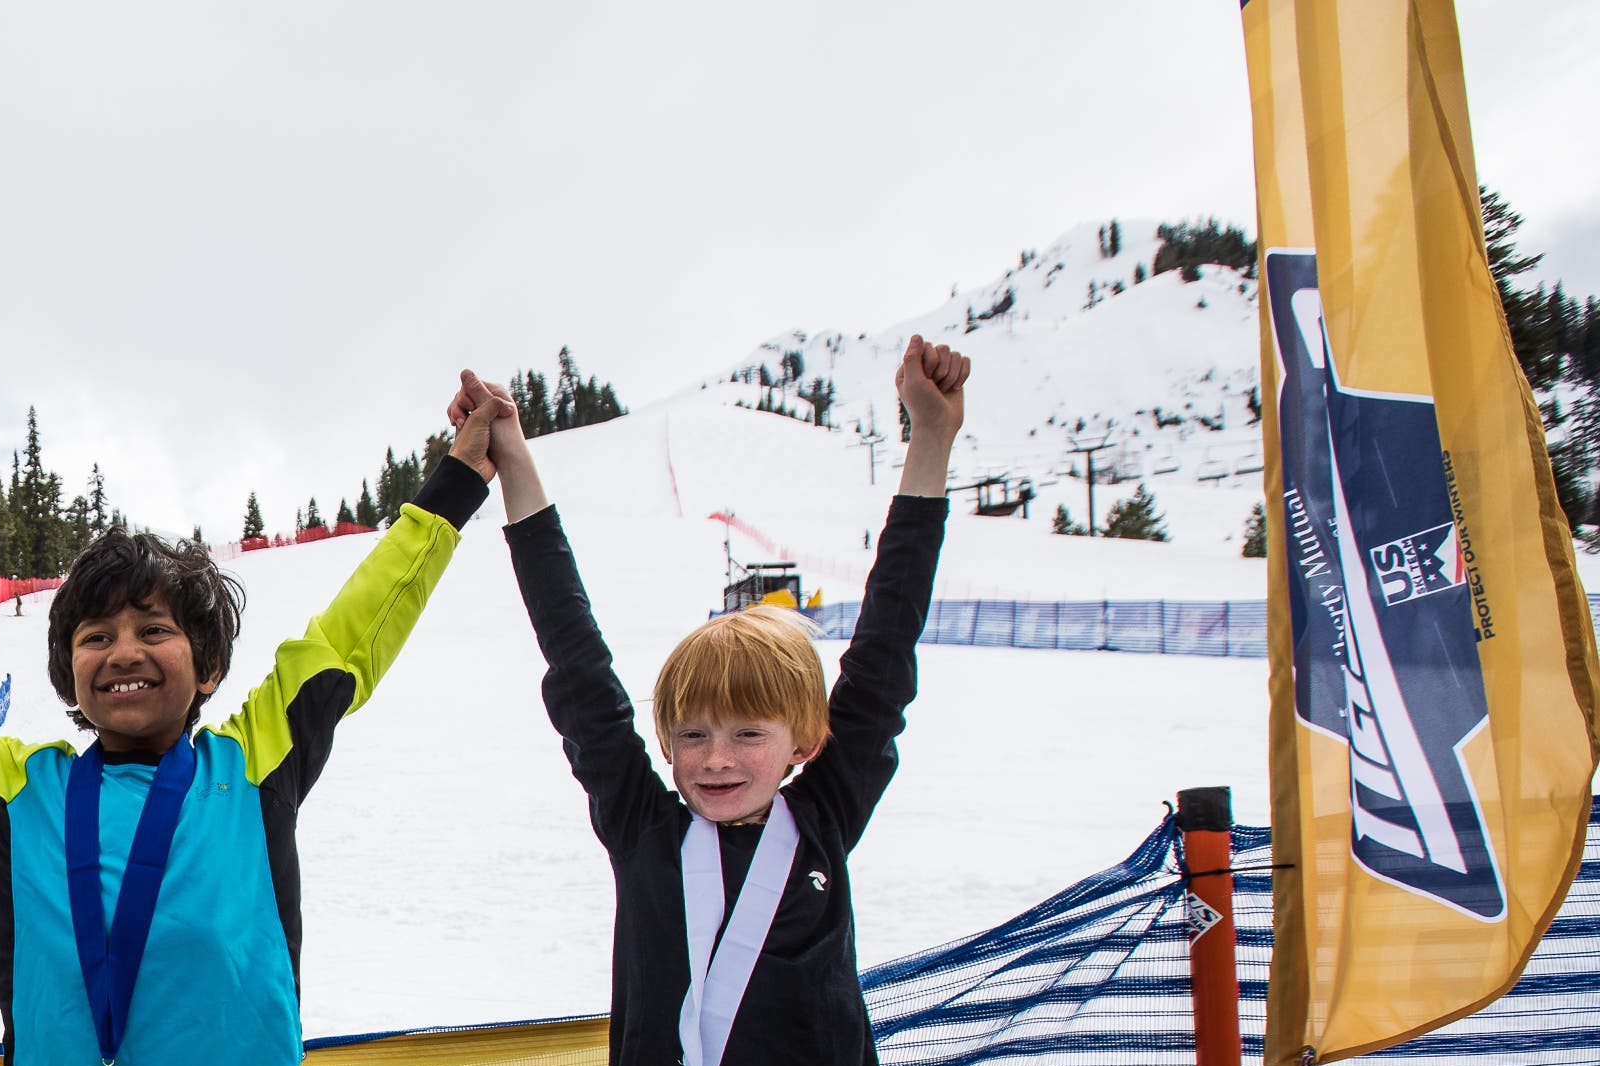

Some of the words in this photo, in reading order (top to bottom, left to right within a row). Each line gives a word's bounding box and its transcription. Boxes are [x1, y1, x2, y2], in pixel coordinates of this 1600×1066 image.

[1373, 543, 1414, 604] US
[1458, 527, 1475, 563] OUR
[1467, 566, 1496, 640] PROTECT
